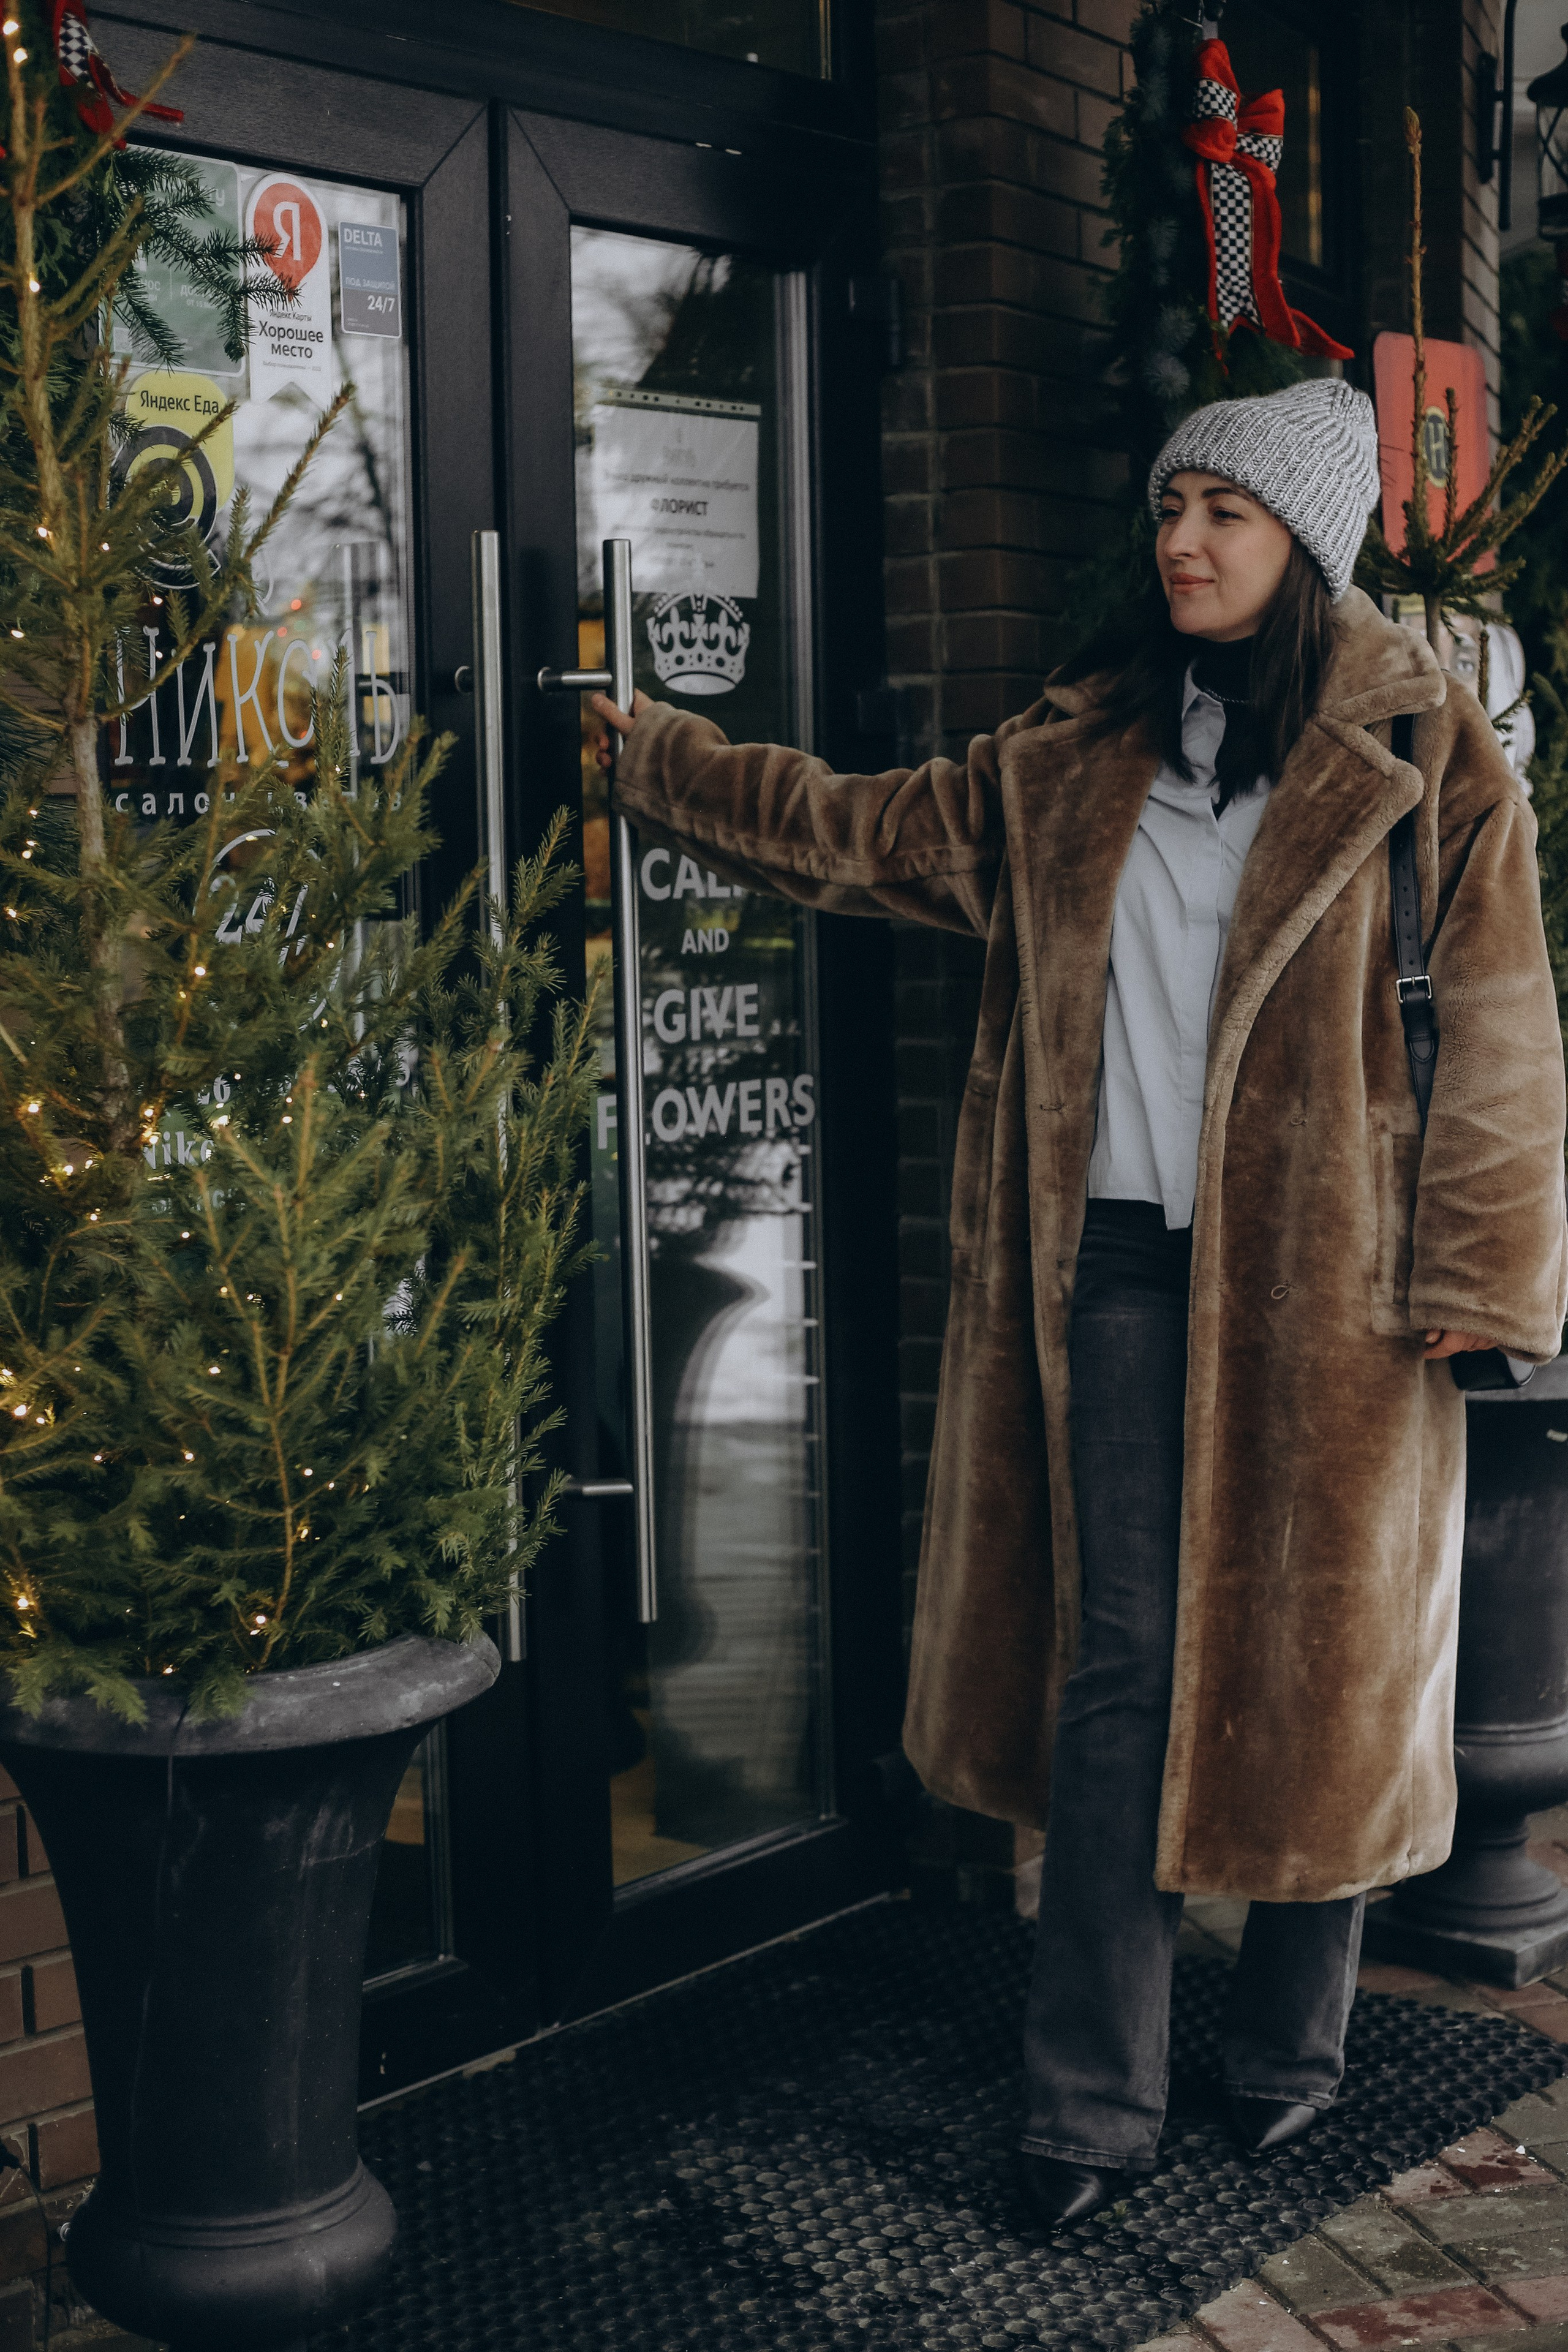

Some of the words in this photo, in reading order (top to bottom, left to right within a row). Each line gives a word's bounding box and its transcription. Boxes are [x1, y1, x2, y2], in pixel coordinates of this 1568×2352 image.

[273, 201, 301, 261] Я
[344, 228, 383, 247] DELTA
[368, 295, 394, 314] 24/7
[258, 320, 323, 343] Хорошее
[271, 344, 312, 358] место
[140, 390, 190, 412] Яндекс
[194, 395, 219, 415] Еда
[681, 927, 729, 955] AND
[654, 983, 760, 1044] GIVE
[597, 1074, 816, 1149] FOWERS
